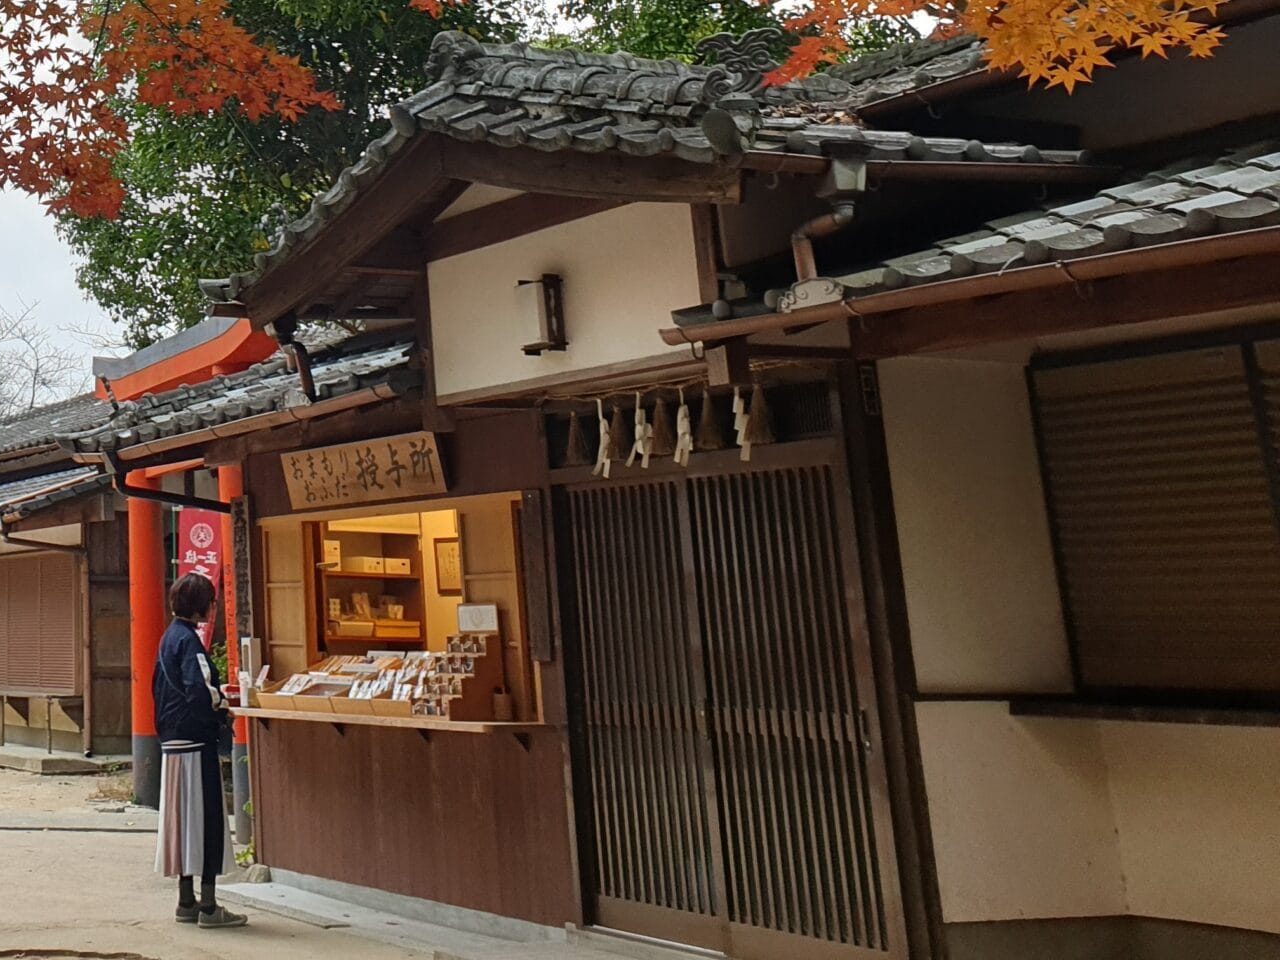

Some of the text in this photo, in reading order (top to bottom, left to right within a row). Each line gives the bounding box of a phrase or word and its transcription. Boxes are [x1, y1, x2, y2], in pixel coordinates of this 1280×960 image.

[290, 448, 349, 481] おまもり
[355, 437, 436, 492] 授与所
[304, 471, 349, 503] おふだ
